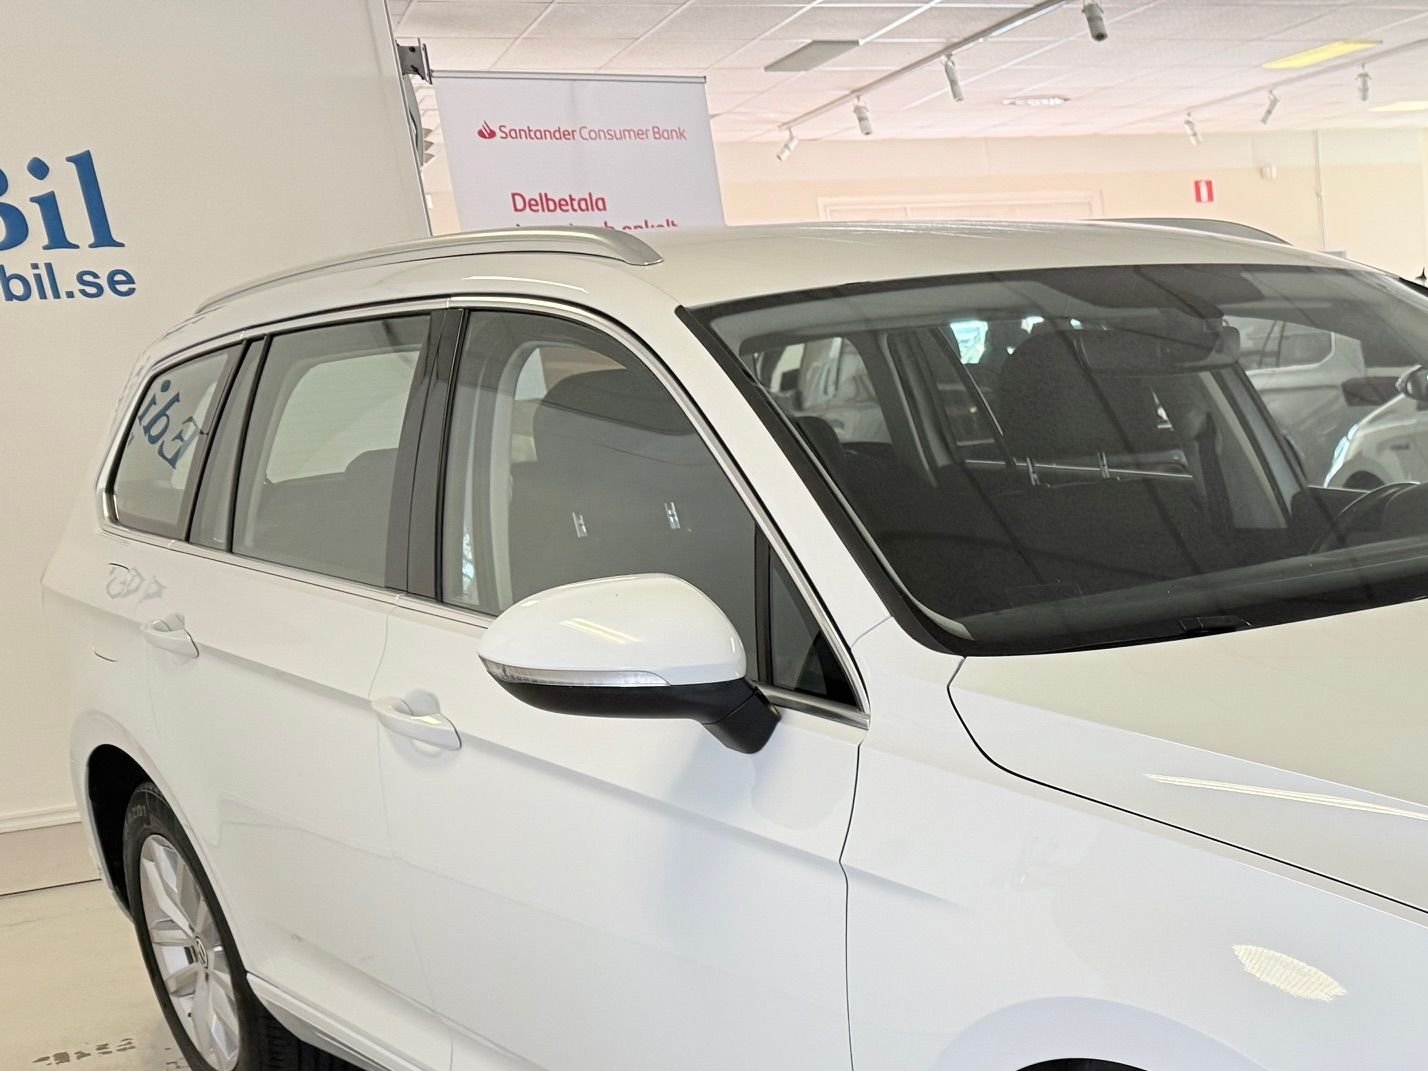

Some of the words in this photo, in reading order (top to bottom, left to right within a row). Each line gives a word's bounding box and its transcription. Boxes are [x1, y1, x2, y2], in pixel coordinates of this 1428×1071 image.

[498, 125, 577, 141] Santander
[579, 126, 650, 141] Consumer
[652, 126, 687, 141] Bank
[511, 192, 608, 213] Delbetala
